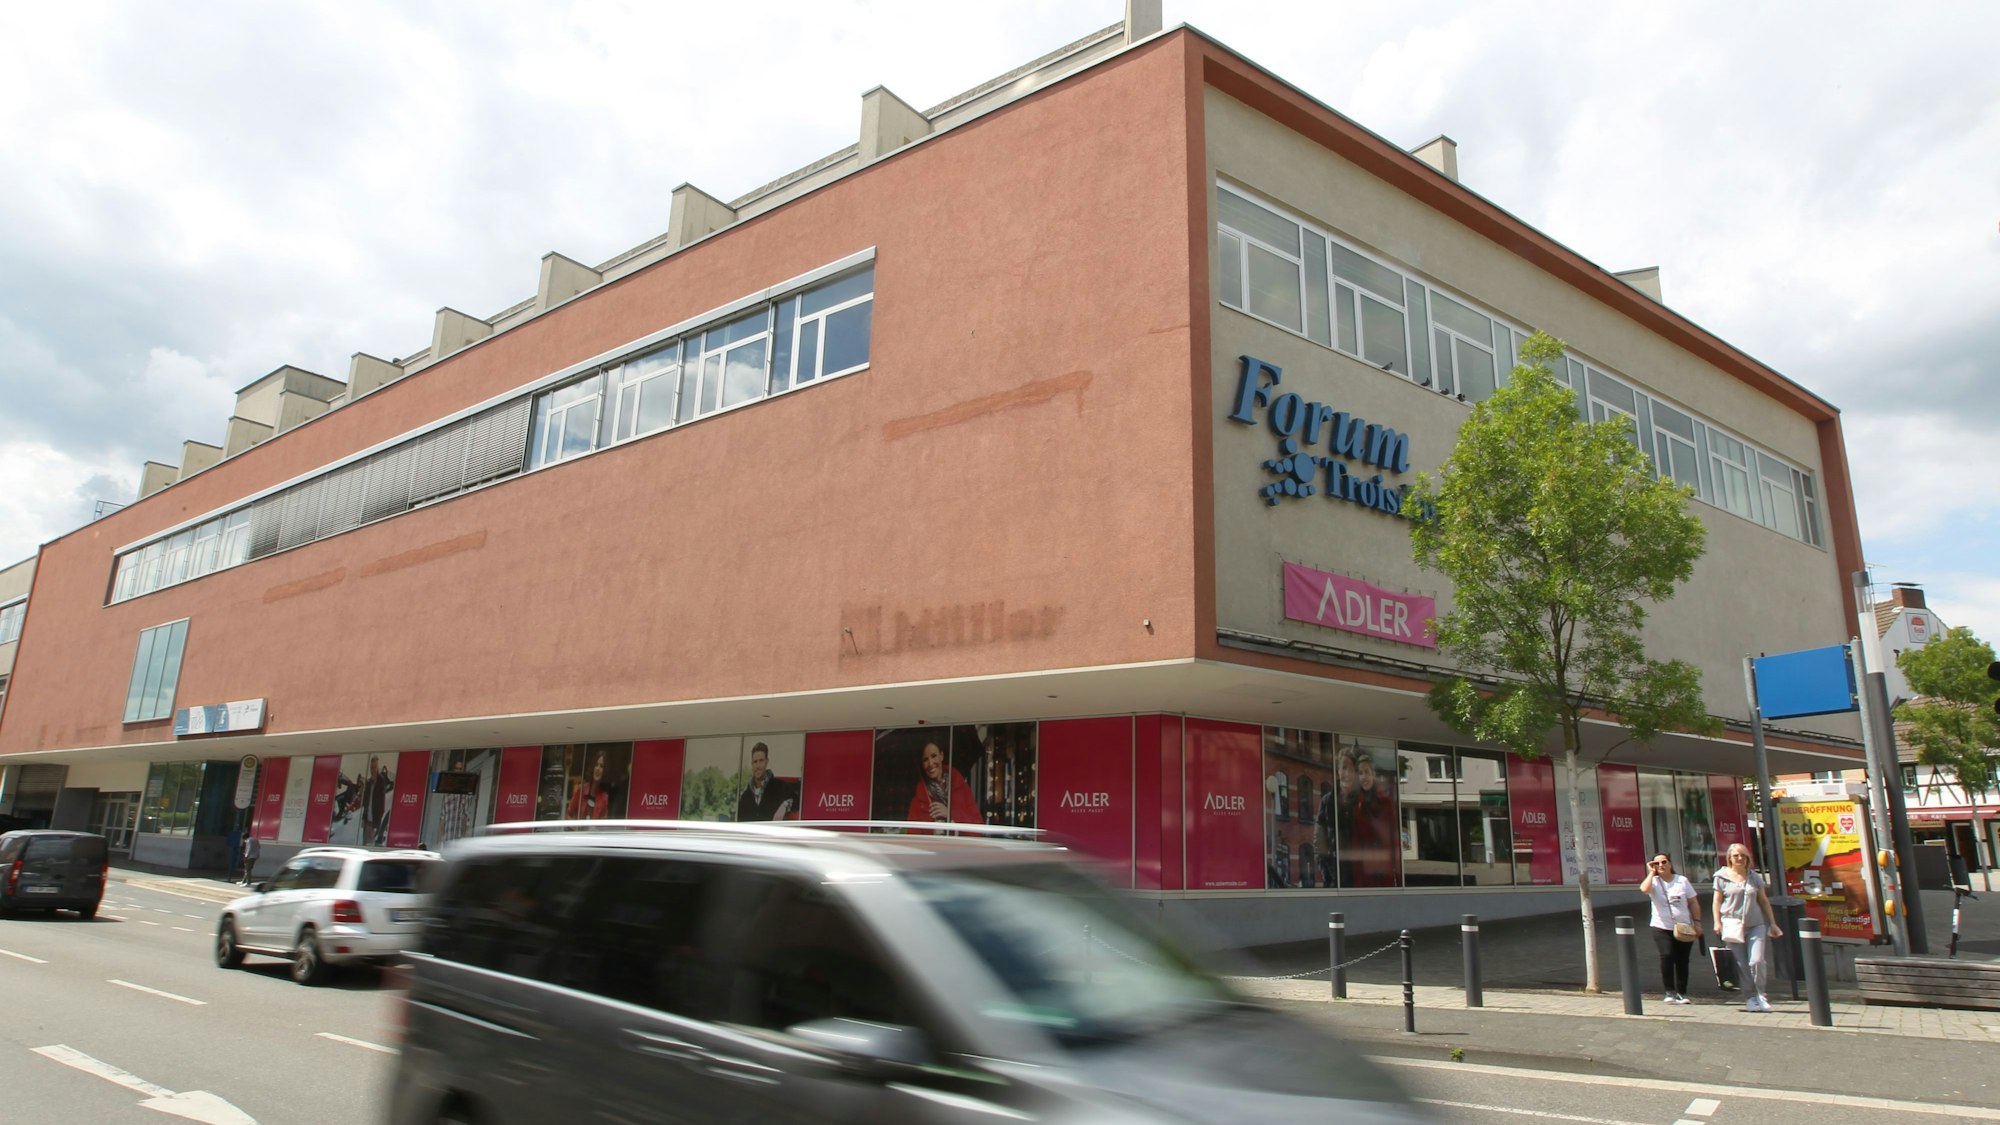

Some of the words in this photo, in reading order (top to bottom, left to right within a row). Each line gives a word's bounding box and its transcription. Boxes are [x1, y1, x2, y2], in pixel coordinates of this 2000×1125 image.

[1227, 354, 1410, 473] Forum
[1320, 456, 1438, 525] Trois
[1316, 577, 1411, 638] ADLER
[400, 794, 418, 804] ADLER
[506, 793, 528, 804] ADLER
[641, 793, 668, 806] ADLER
[818, 792, 854, 807] ADLER
[1060, 790, 1110, 808] ADLER
[1203, 791, 1246, 810] ADLER
[1521, 809, 1547, 824] ADLER
[1781, 804, 1853, 814] NEUERÖFFNUNG
[1611, 815, 1633, 828] ADLER
[1719, 821, 1737, 832] ADLER
[1782, 819, 1838, 835] tedox
